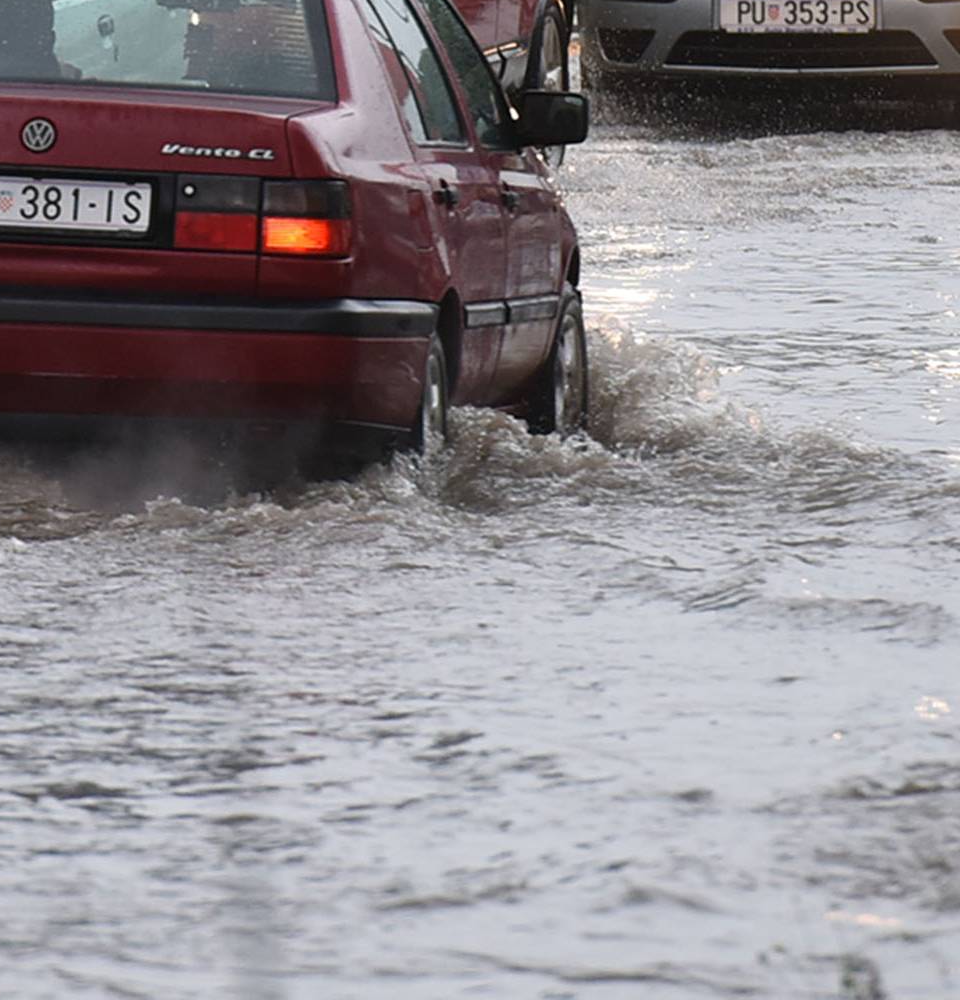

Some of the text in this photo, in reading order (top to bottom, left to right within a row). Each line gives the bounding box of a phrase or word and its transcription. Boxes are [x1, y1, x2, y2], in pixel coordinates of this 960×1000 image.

[737, 0, 870, 25] PU 353-PS
[161, 143, 275, 160] Vento CL
[19, 185, 143, 223] 381-IS
